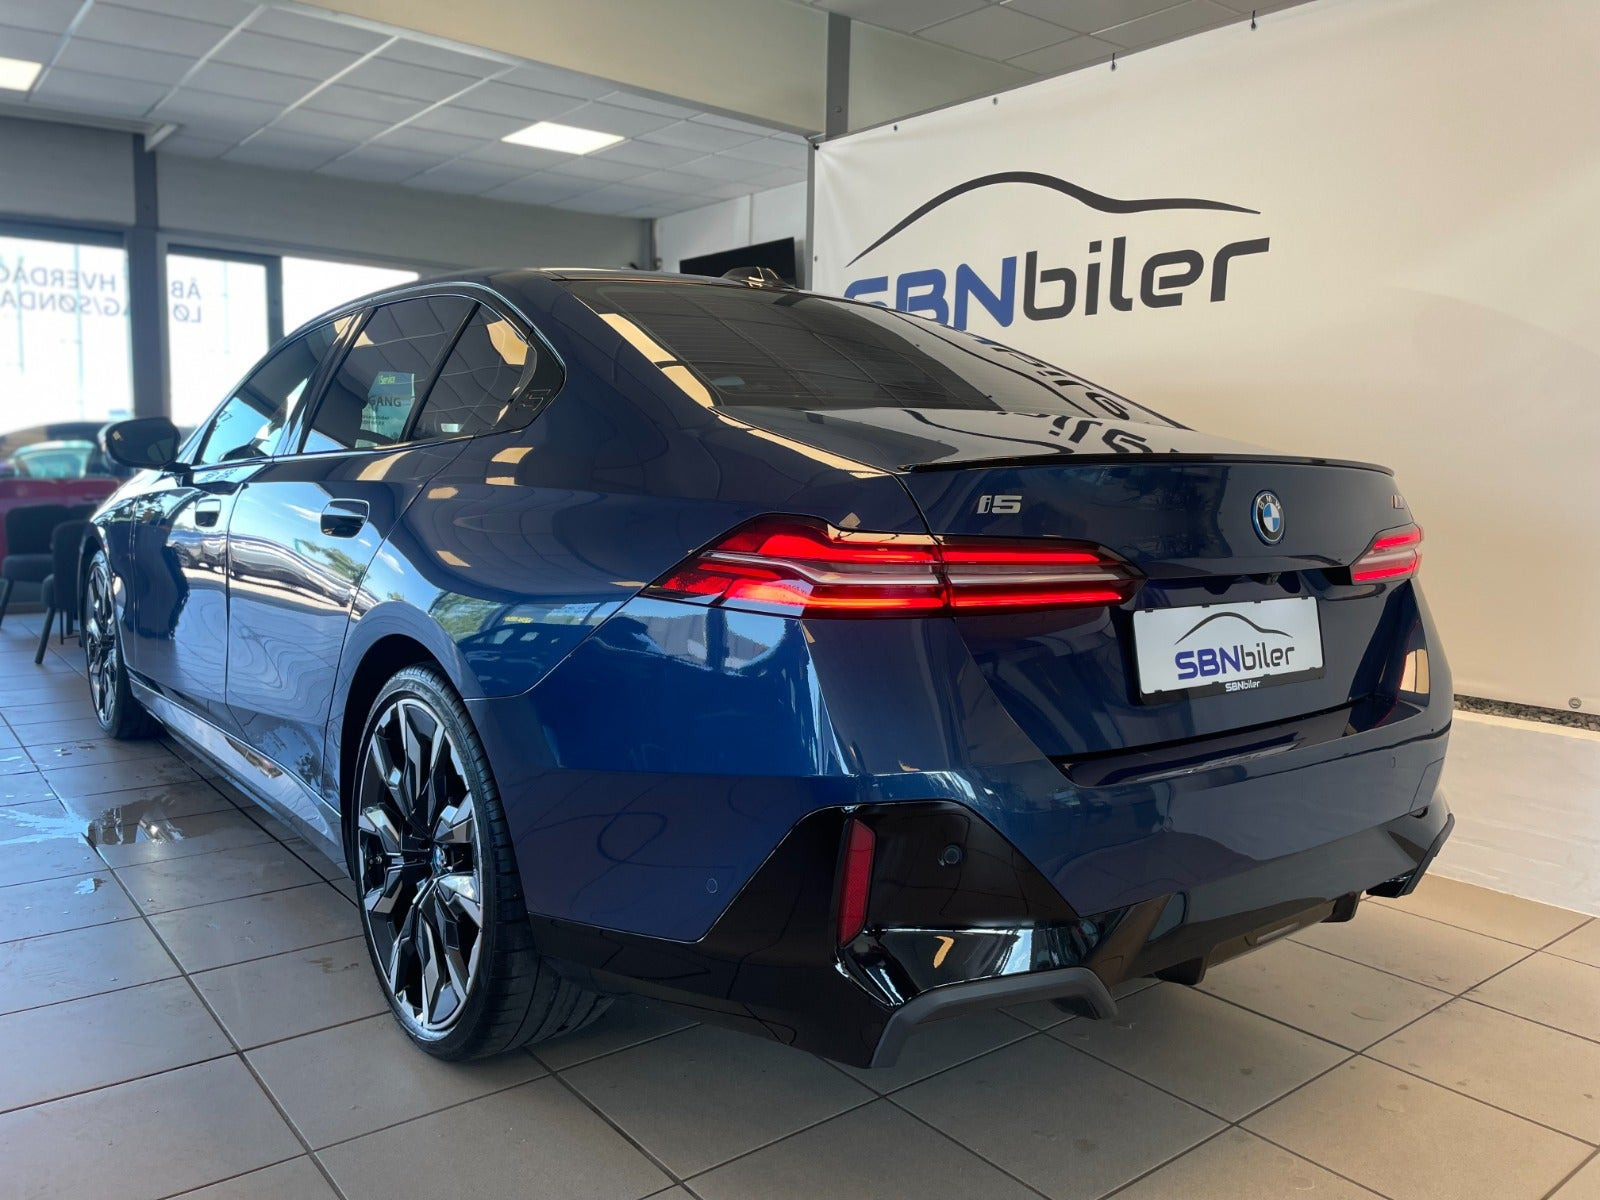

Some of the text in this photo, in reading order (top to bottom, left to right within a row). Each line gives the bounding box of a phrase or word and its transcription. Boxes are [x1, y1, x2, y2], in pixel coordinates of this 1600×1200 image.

[977, 495, 1022, 514] i5
[1175, 642, 1295, 680] SBNbiler
[1225, 680, 1260, 692] SBNbiler
